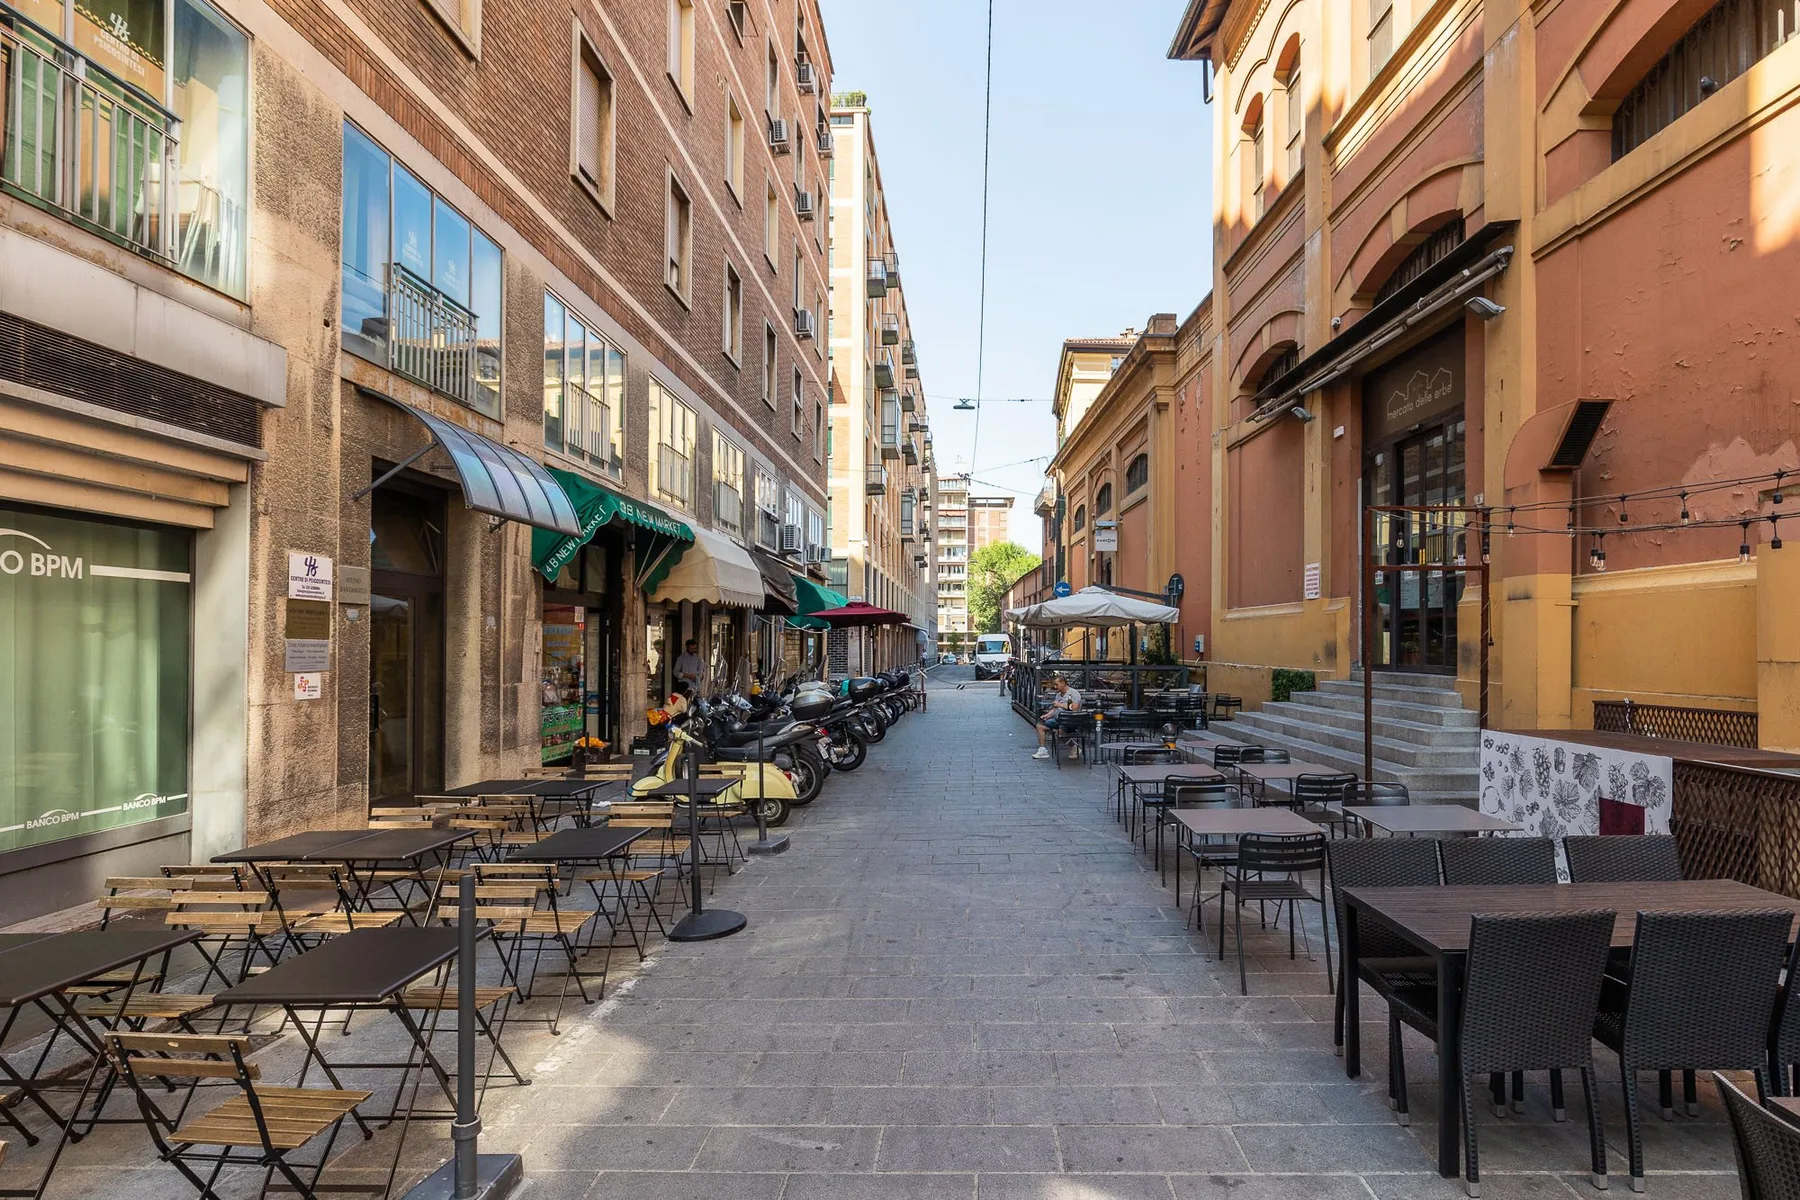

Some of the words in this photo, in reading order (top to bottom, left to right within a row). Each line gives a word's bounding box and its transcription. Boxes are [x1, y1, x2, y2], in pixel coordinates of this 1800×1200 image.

[1415, 390, 1432, 408] delle
[1434, 381, 1452, 399] erbe
[636, 508, 654, 525] NEW
[655, 514, 682, 535] MARKET
[556, 540, 576, 563] NEW
[30, 552, 83, 580] BPM
[123, 798, 151, 811] BANCO
[151, 795, 166, 806] BPM
[26, 815, 61, 830] BANCO
[61, 811, 80, 823] BPM
